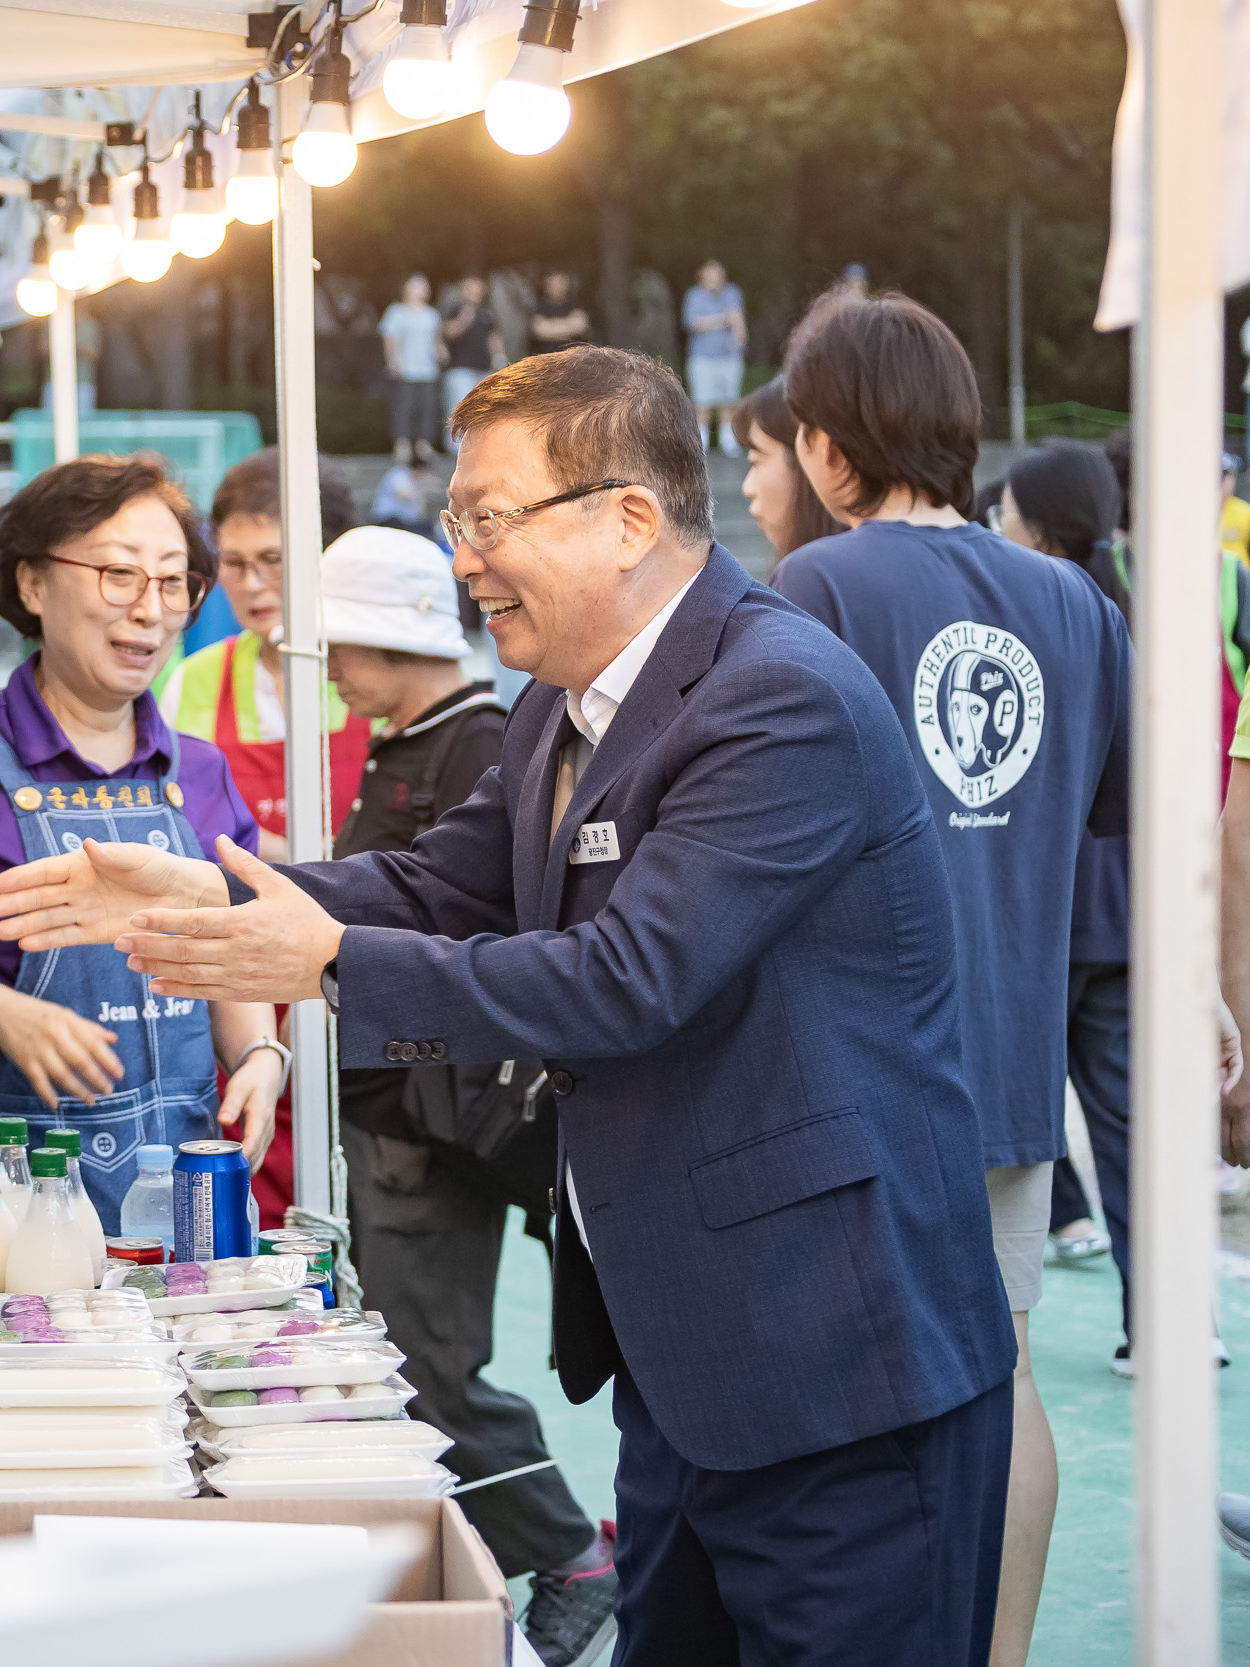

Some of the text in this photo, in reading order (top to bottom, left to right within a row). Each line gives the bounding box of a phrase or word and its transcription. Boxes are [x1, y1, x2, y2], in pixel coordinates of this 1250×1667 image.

[984, 632, 1042, 726] PRODUCT
[998, 700, 1014, 726] P
[960, 775, 998, 802] PHIZ
[582, 828, 610, 845] 김경호
[97, 1001, 139, 1023] Jean
[141, 999, 161, 1020] &
